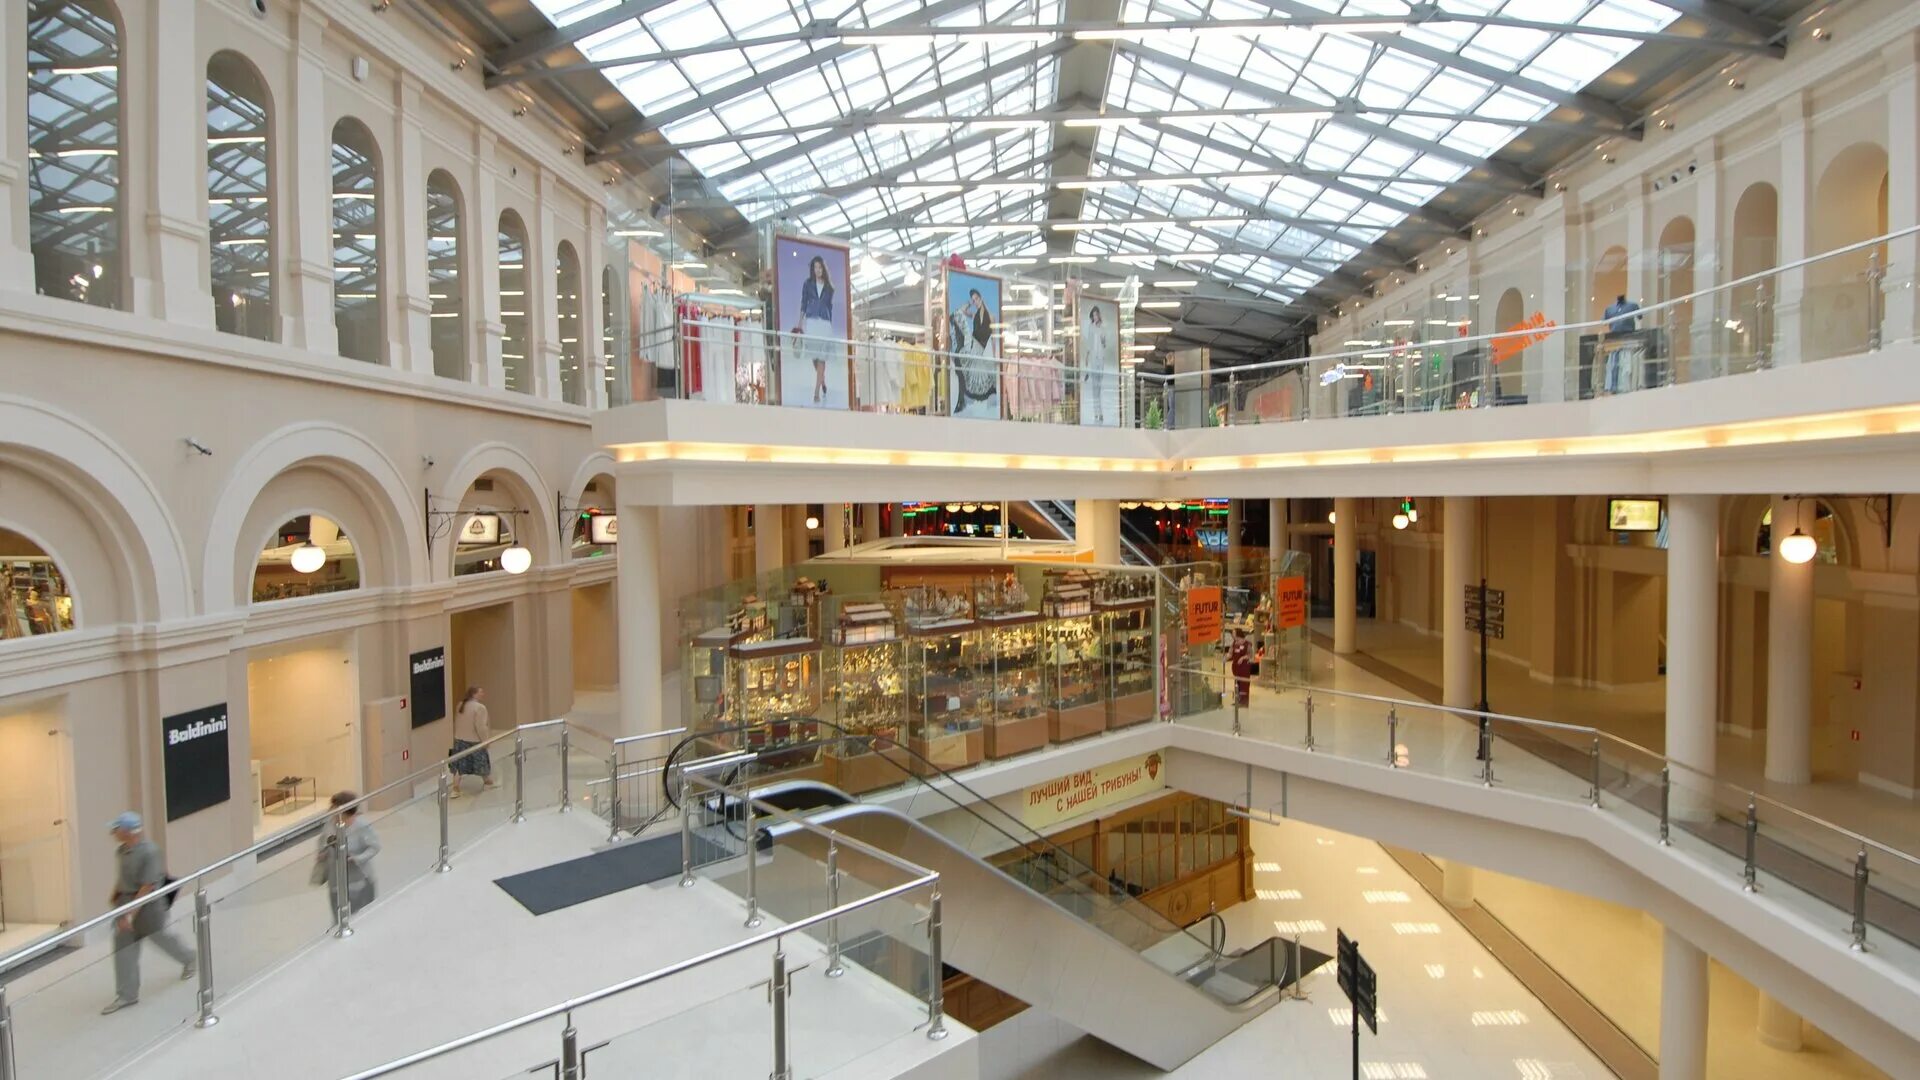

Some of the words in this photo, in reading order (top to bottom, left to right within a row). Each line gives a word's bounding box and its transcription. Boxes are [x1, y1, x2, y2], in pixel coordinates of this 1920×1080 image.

[1195, 601, 1219, 615] FUTUR
[412, 656, 444, 675] Baldinini
[168, 715, 227, 746] Baldinini
[1029, 776, 1071, 806] ЛУЧШИЙ
[1073, 770, 1093, 789] ВИД
[1056, 799, 1063, 812] С
[1066, 783, 1098, 810] НАШЕЙ
[1100, 767, 1142, 795] ТРИБУНЫ!
